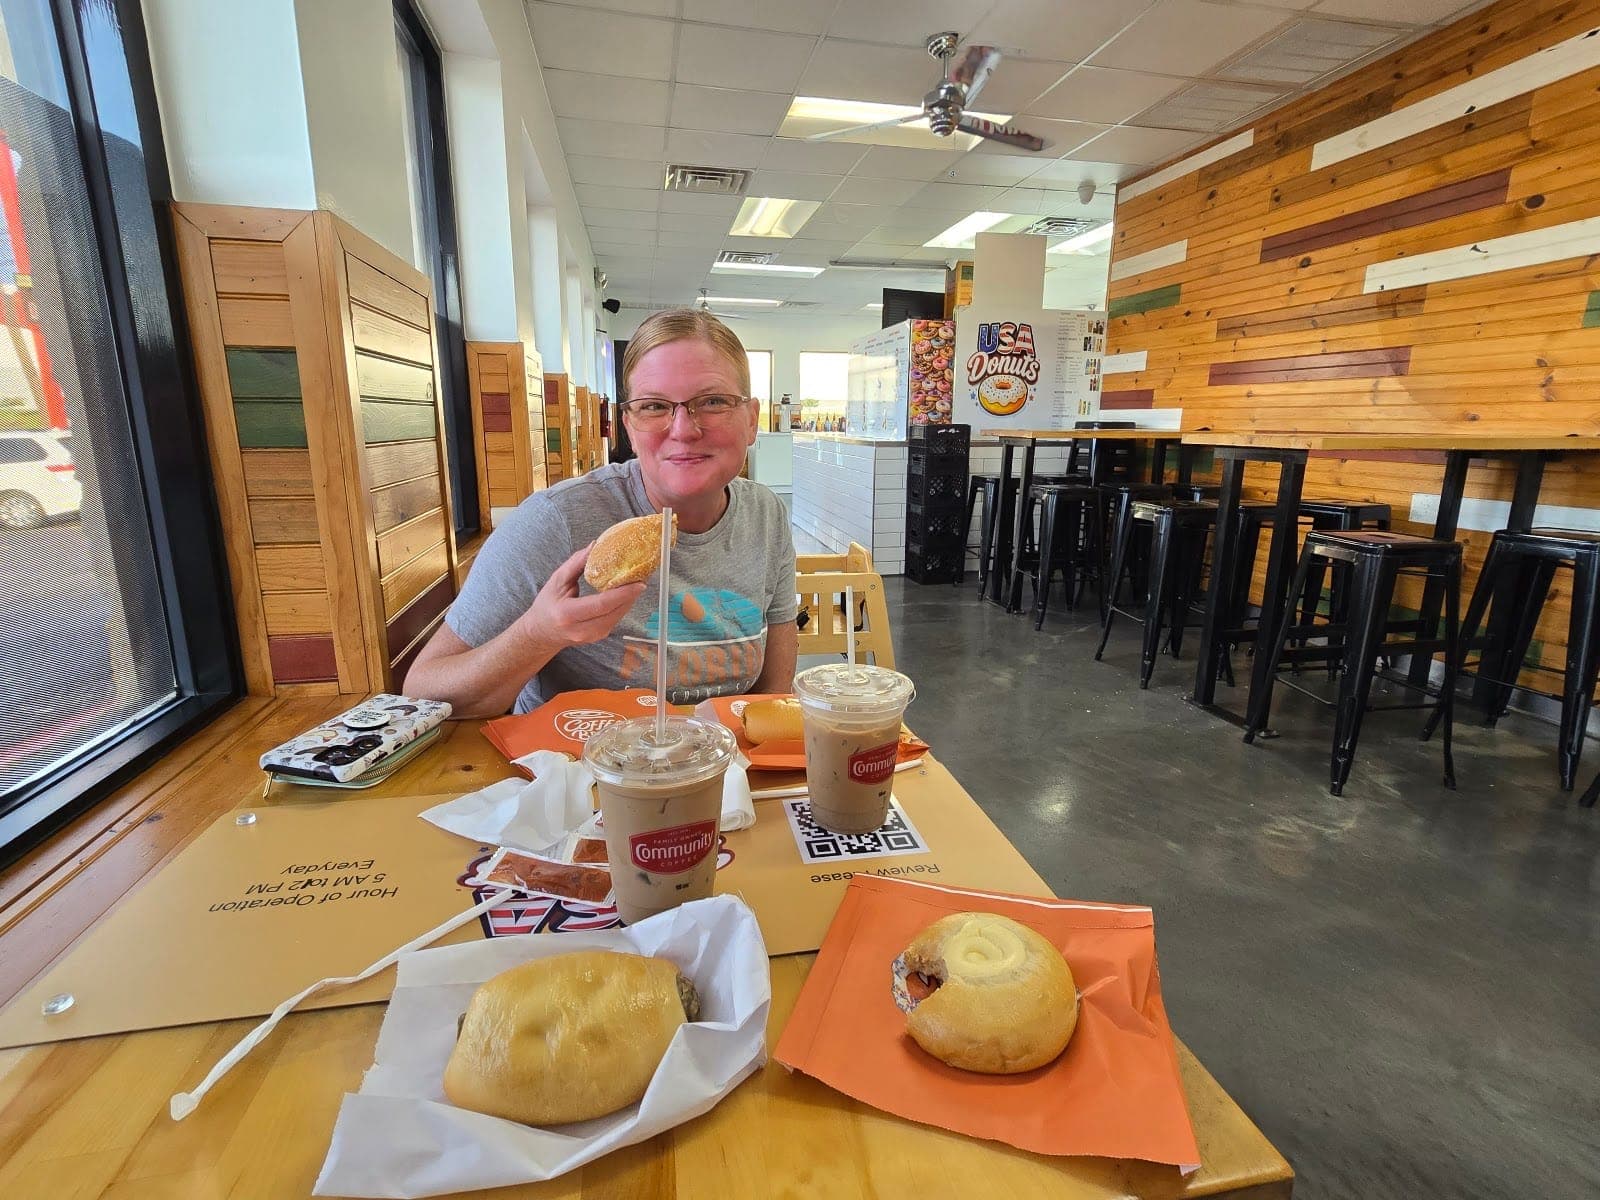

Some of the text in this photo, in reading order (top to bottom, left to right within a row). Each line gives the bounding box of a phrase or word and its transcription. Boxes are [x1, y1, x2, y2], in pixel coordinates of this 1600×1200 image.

[977, 322, 1036, 356] USA
[967, 351, 1040, 384] Donuts
[619, 640, 764, 687] FLORID
[636, 830, 714, 863] Community
[280, 860, 375, 876] Everyday
[372, 873, 387, 884] 5
[810, 864, 940, 884] Review ease
[245, 882, 285, 895] PM
[333, 874, 370, 888] AM
[208, 885, 399, 913] Hour of Operation
